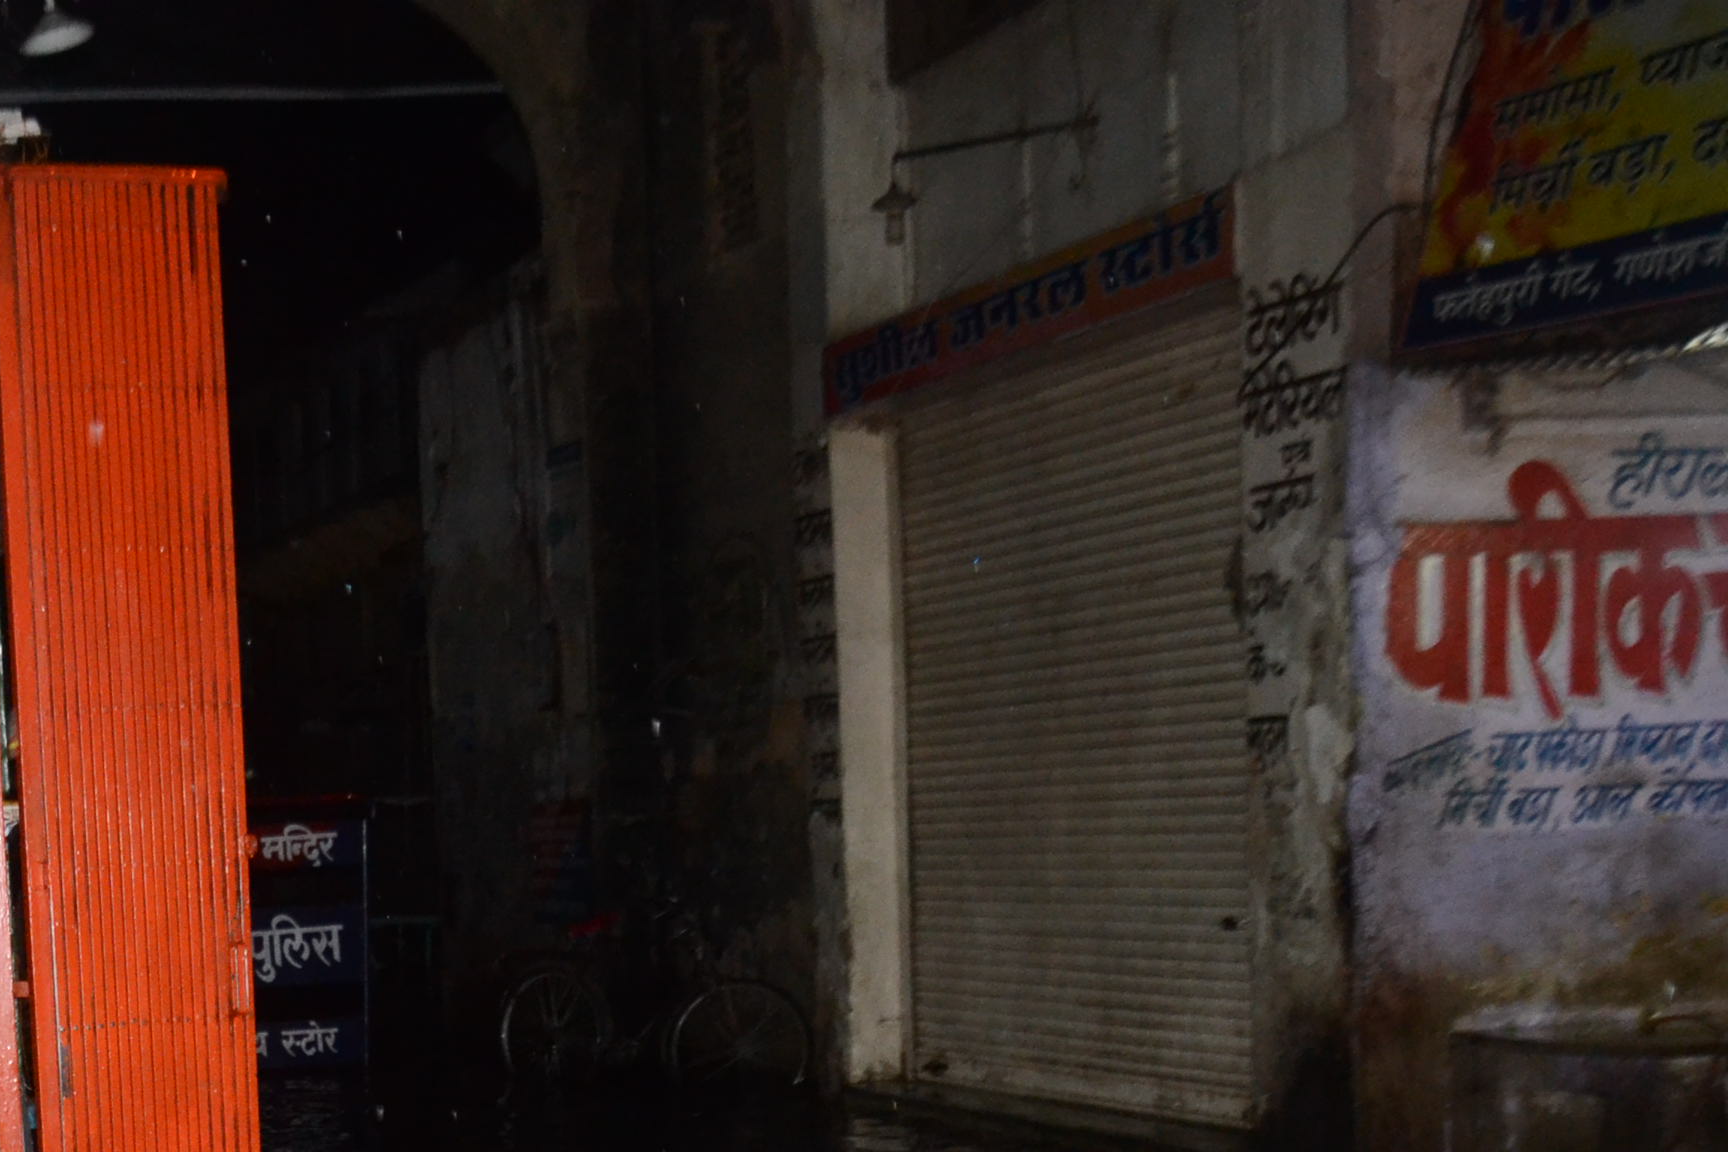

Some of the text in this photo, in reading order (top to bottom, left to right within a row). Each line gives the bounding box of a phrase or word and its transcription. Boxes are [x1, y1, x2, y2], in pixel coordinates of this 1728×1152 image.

[260, 824, 339, 868] मन्दिर
[252, 914, 344, 983] पुलिस
[280, 1019, 340, 1058] स्टोर
